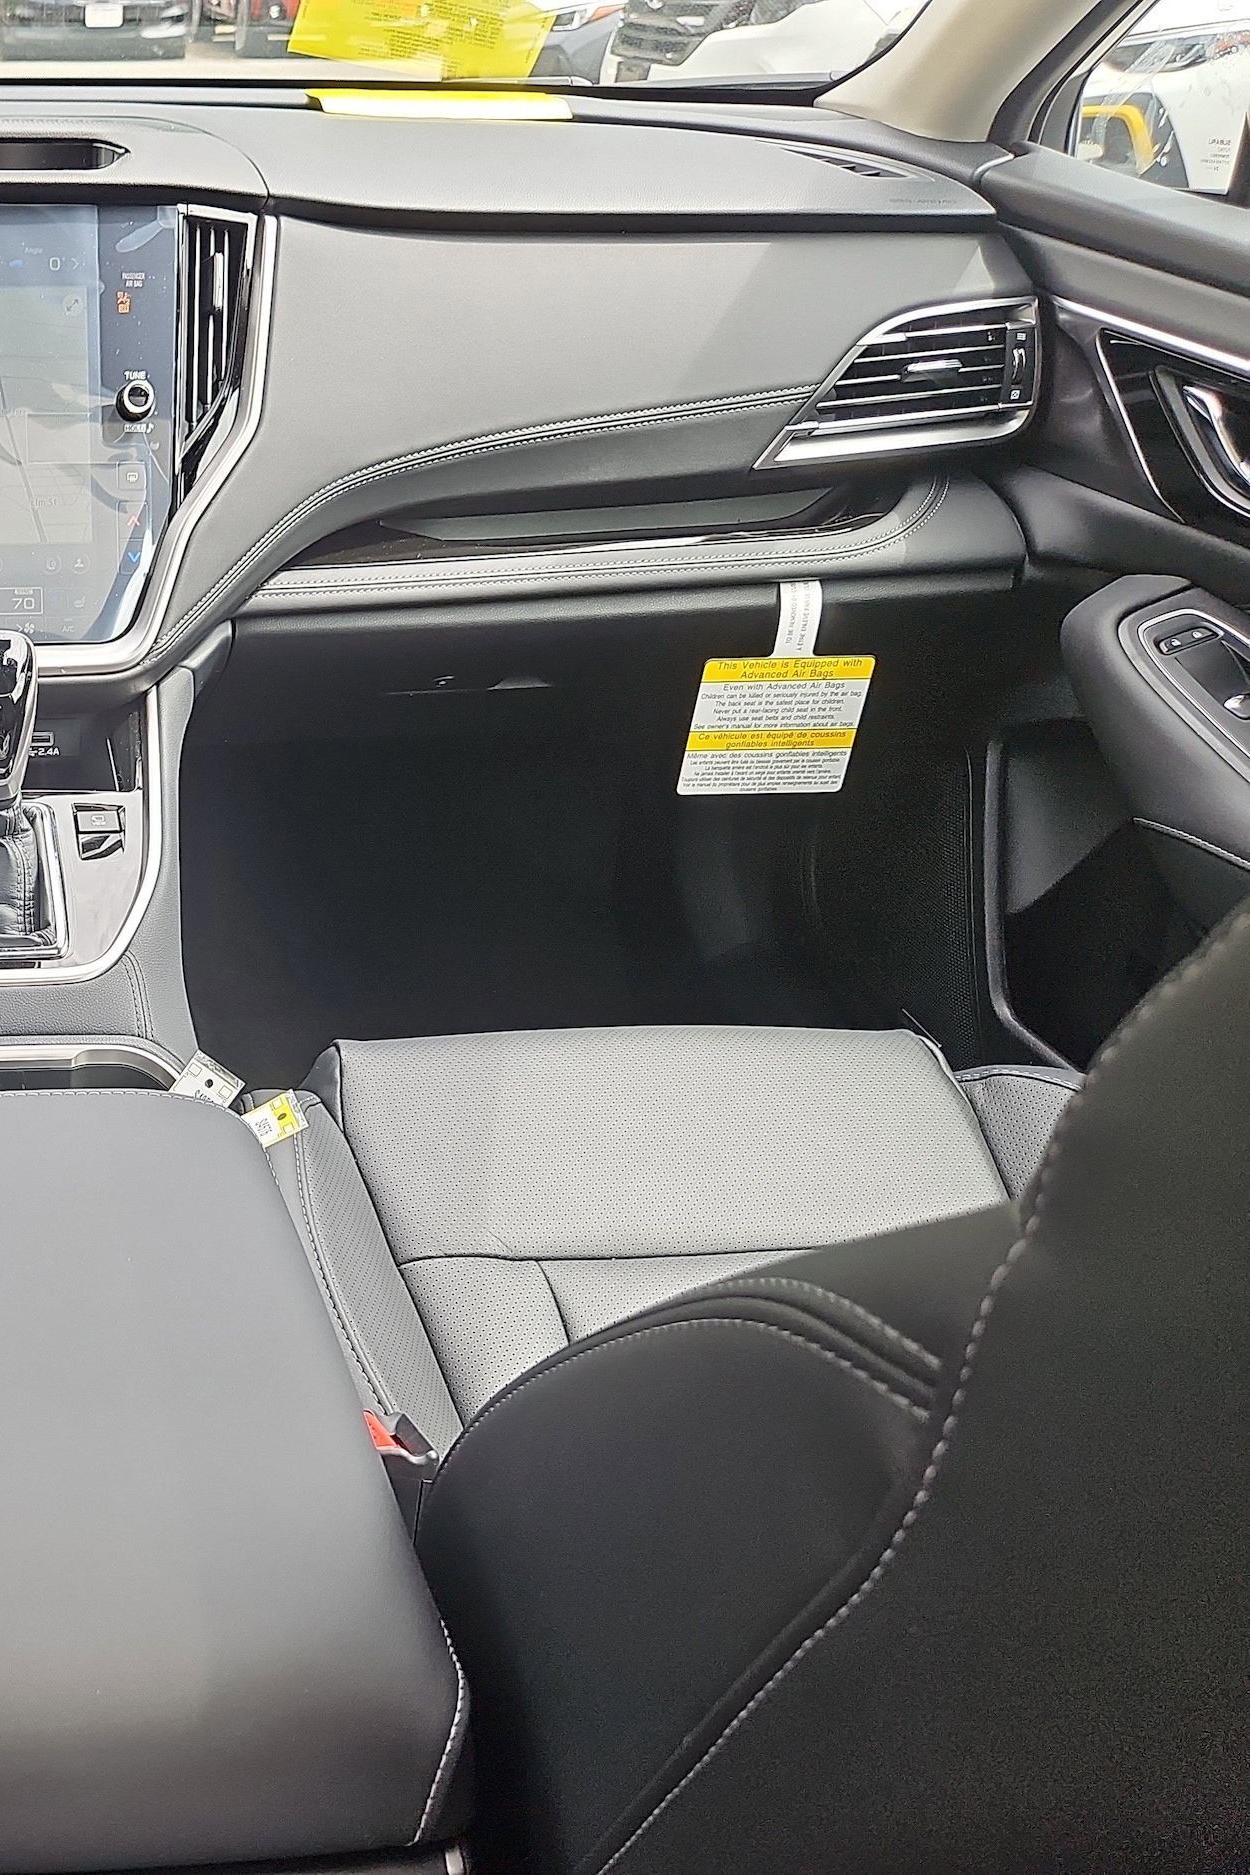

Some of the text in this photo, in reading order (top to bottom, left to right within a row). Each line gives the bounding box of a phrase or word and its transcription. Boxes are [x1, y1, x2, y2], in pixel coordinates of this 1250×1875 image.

[134, 280, 143, 288] BAG
[124, 371, 146, 380] TUNE
[31, 498, 57, 506] Elm St
[12, 598, 35, 610] 70
[718, 659, 862, 670] This Vehicle is Equipped with
[740, 670, 834, 679] Advanced Air Bags
[766, 682, 807, 690] Advanced
[824, 682, 845, 690] Bags
[766, 732, 793, 740] équipé
[726, 740, 814, 750] gonflables intelligents
[37, 748, 60, 756] 2.4A
